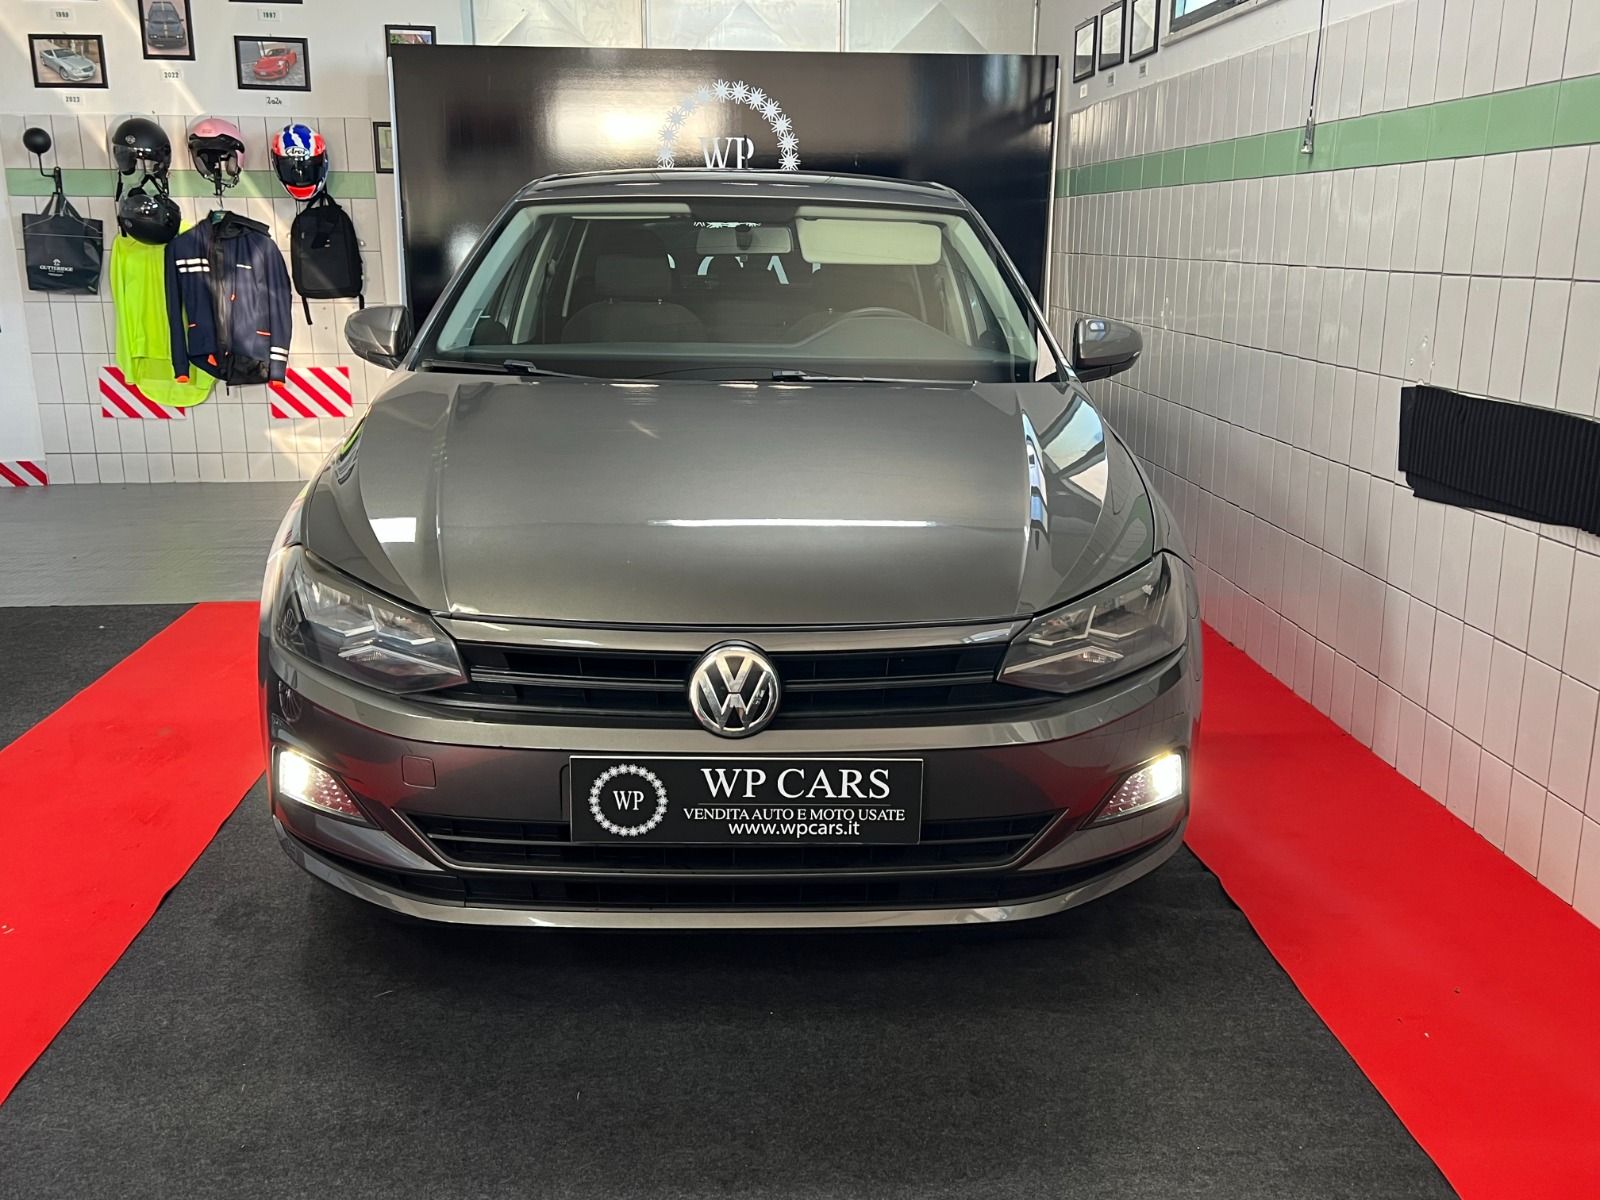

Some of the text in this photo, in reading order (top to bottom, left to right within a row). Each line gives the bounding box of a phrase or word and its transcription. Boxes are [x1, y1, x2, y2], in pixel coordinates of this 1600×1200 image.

[700, 136, 755, 169] WP
[700, 768, 890, 799] WP CARS
[612, 790, 645, 811] WP
[683, 807, 906, 821] VENDITA AUTO E MOTO USATE
[728, 820, 861, 839] www.wpcars.it
